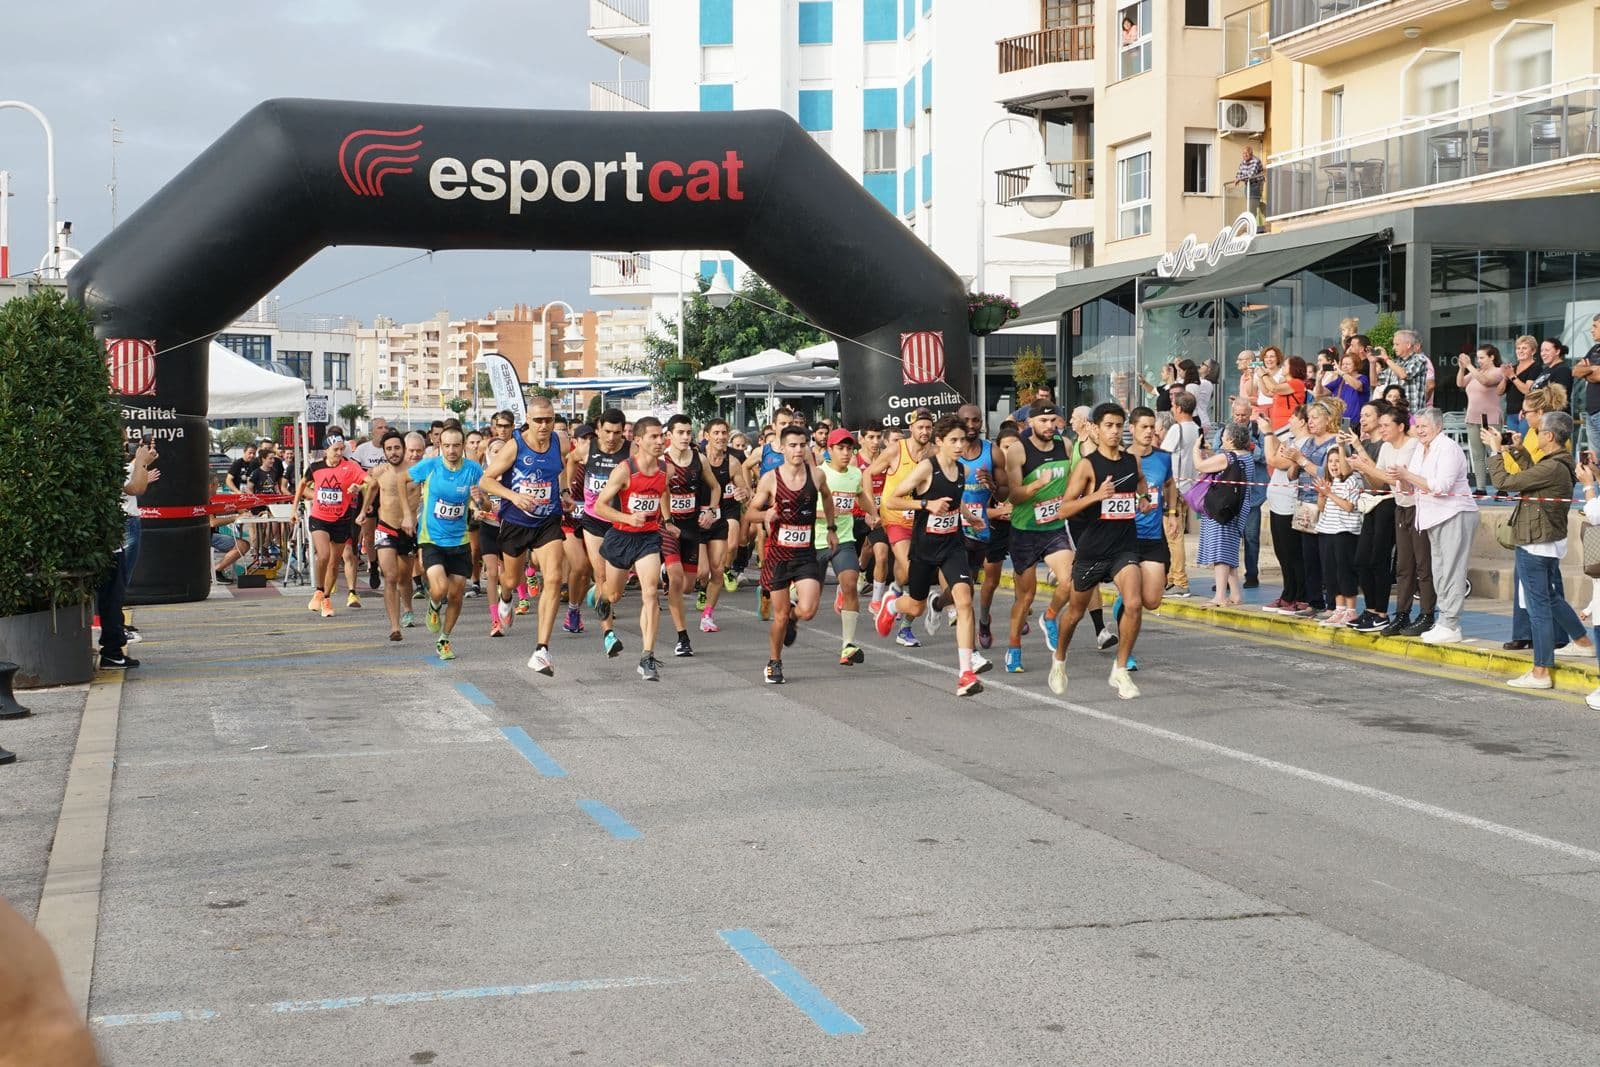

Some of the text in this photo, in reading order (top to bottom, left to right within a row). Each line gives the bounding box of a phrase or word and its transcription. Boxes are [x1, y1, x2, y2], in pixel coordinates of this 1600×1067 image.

[429, 150, 744, 214] esportcat
[888, 392, 961, 409] Generalitat
[120, 406, 177, 420] eralitat
[882, 414, 900, 427] de
[594, 480, 607, 490] 04
[321, 492, 338, 501] 049
[633, 499, 655, 511] 280
[671, 499, 691, 509] 258
[1108, 500, 1131, 512] 262
[440, 505, 460, 516] 019
[933, 516, 955, 529] 259
[784, 530, 806, 542] 290
